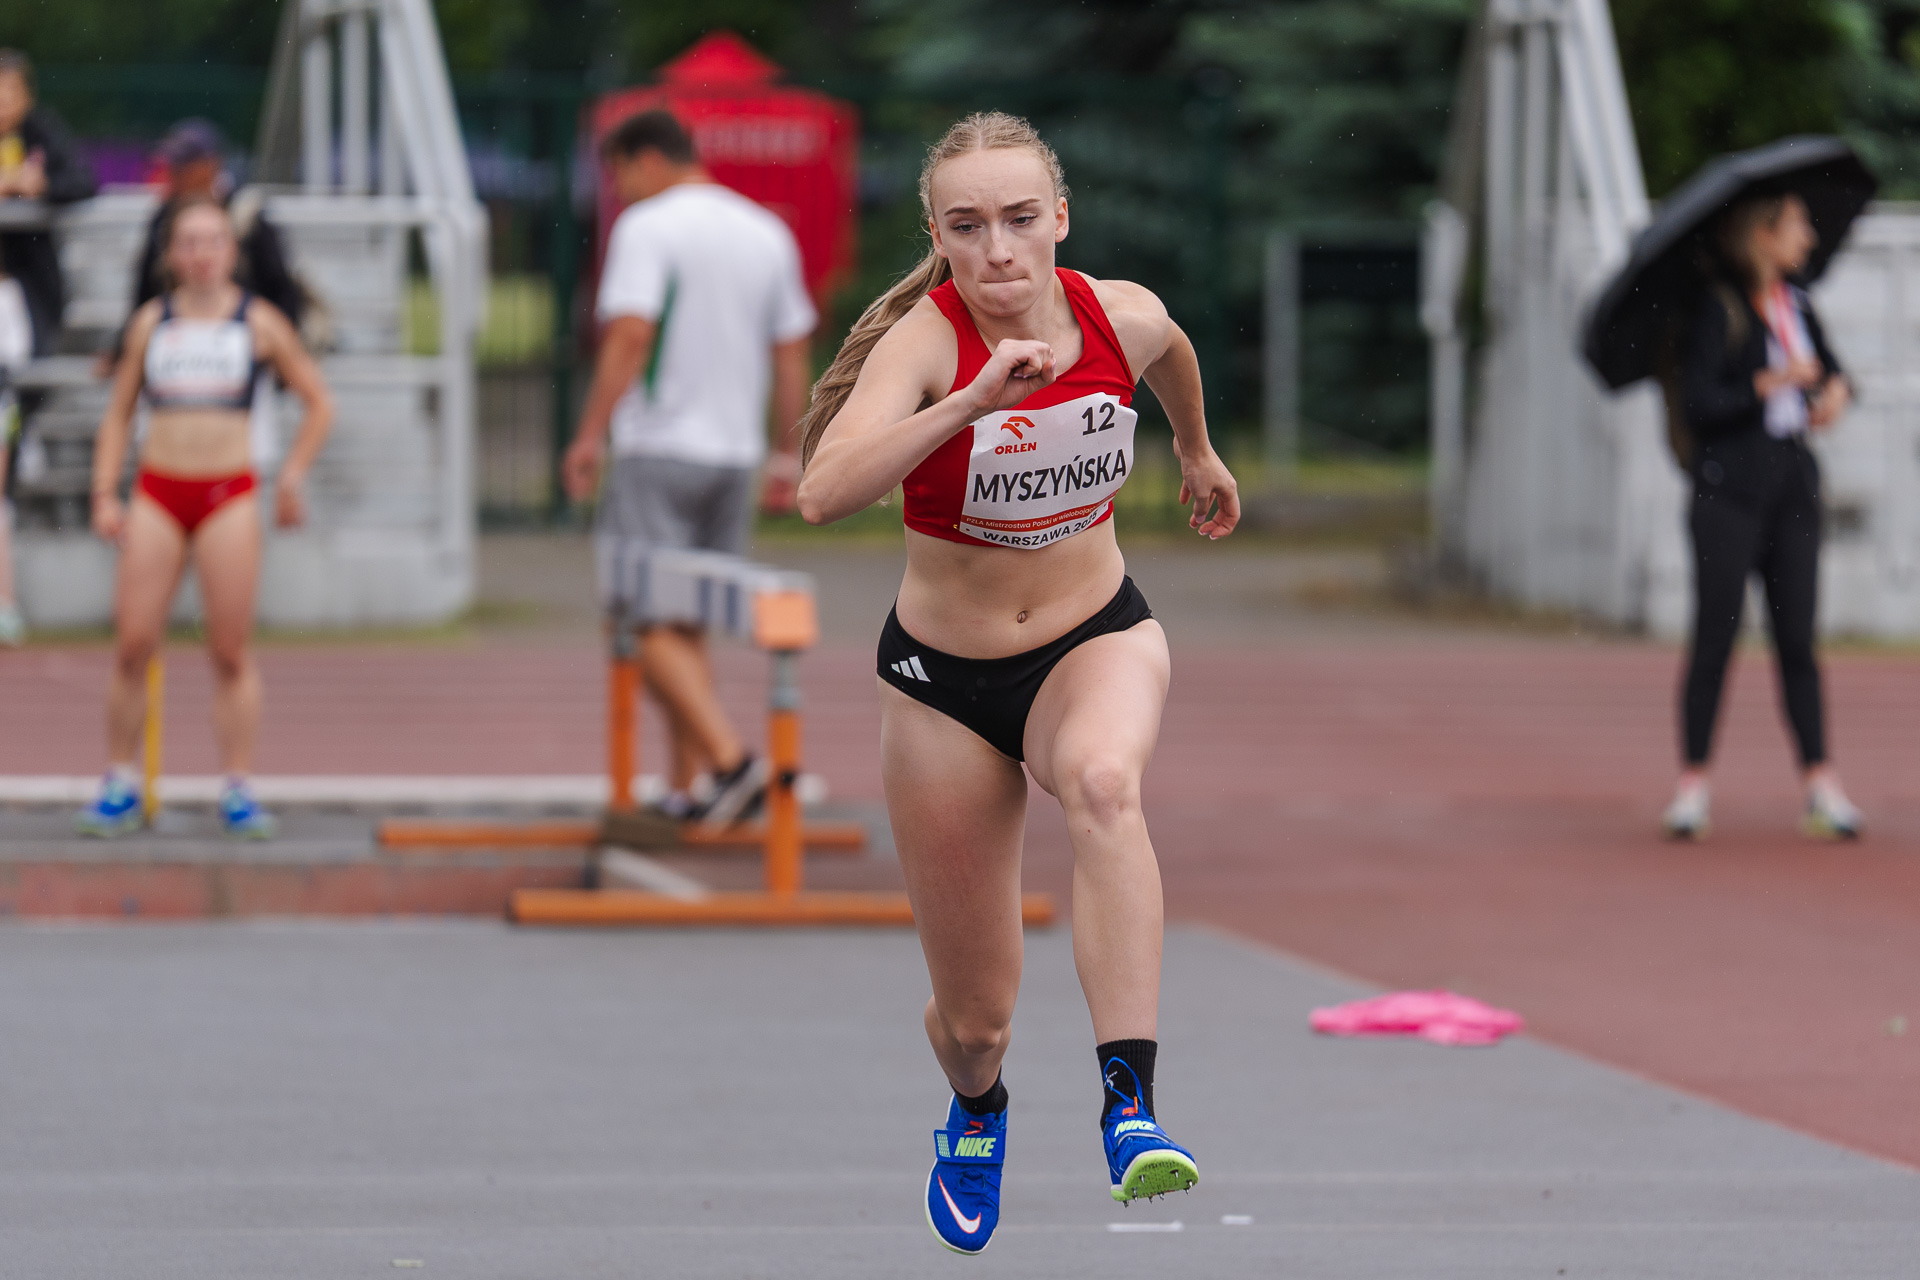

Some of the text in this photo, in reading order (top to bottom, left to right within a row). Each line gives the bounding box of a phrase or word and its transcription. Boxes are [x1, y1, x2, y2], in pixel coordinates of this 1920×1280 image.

[1081, 402, 1116, 436] 12
[994, 441, 1037, 455] ORLEN
[972, 448, 1127, 503] MYSZYŃSKA
[966, 517, 984, 526] PZLA
[985, 521, 1031, 529] Mistrzostwa
[1032, 516, 1052, 527] Polski
[983, 525, 1070, 546] WARSZAWA
[1114, 1119, 1157, 1138] NIKE
[954, 1136, 997, 1157] NIKE
